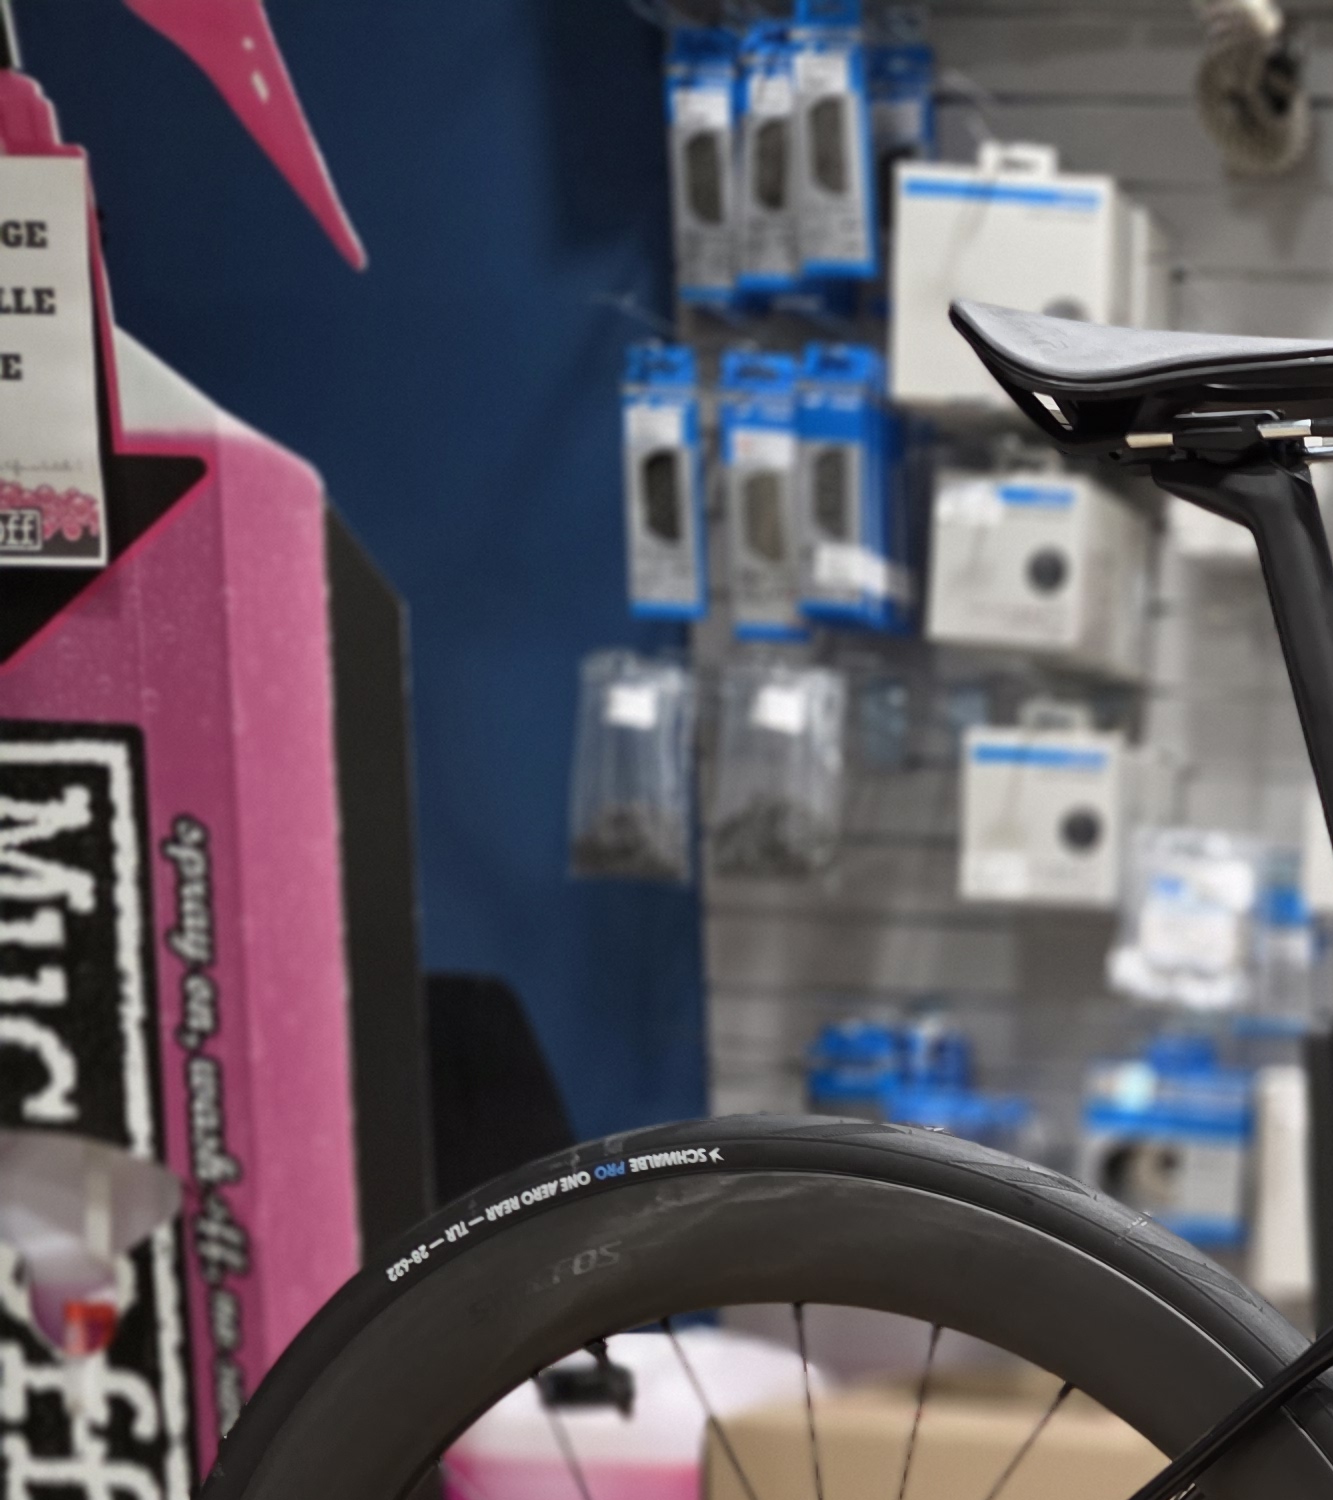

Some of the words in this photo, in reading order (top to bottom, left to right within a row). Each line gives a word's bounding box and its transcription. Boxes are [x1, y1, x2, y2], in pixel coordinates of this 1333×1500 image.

[593, 1160, 626, 1181] PRO
[629, 1147, 708, 1174] SCHWALBE
[521, 1180, 558, 1206] AERO
[559, 1170, 592, 1194] ONE
[486, 1197, 521, 1222] REAR
[445, 1219, 469, 1243] TLR
[386, 1244, 430, 1282] 28-622
